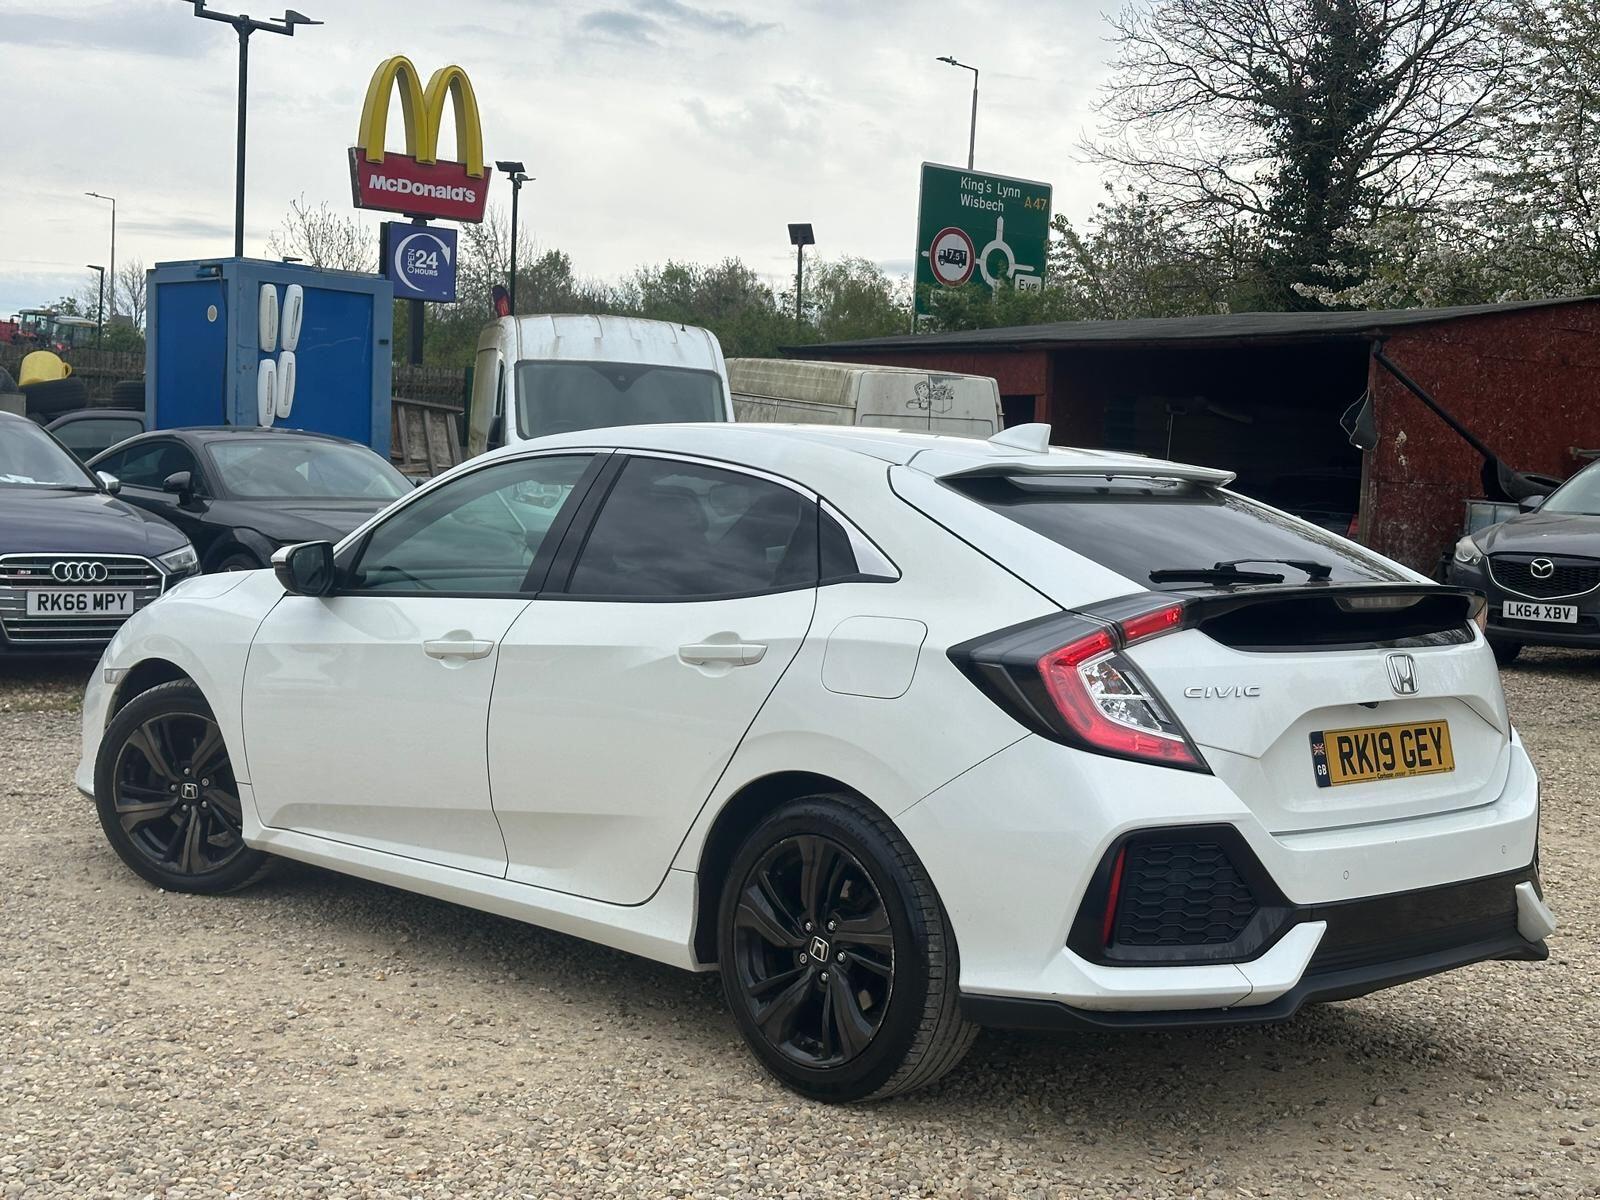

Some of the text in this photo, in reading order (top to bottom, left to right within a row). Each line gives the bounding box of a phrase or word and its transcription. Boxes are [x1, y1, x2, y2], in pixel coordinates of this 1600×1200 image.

[368, 174, 476, 203] McDonald's
[960, 176, 1021, 198] King's Lynn
[960, 193, 1004, 212] Wisbech
[1024, 196, 1047, 211] A47
[407, 248, 415, 273] OPEN
[415, 249, 438, 269] 24
[414, 267, 438, 277] HOURS
[37, 593, 127, 611] RK66 MPY
[1508, 603, 1571, 620] LK64 XBV
[1184, 686, 1261, 699] CIVIC
[1337, 727, 1443, 776] RK19 GEY
[1317, 764, 1327, 776] GB
